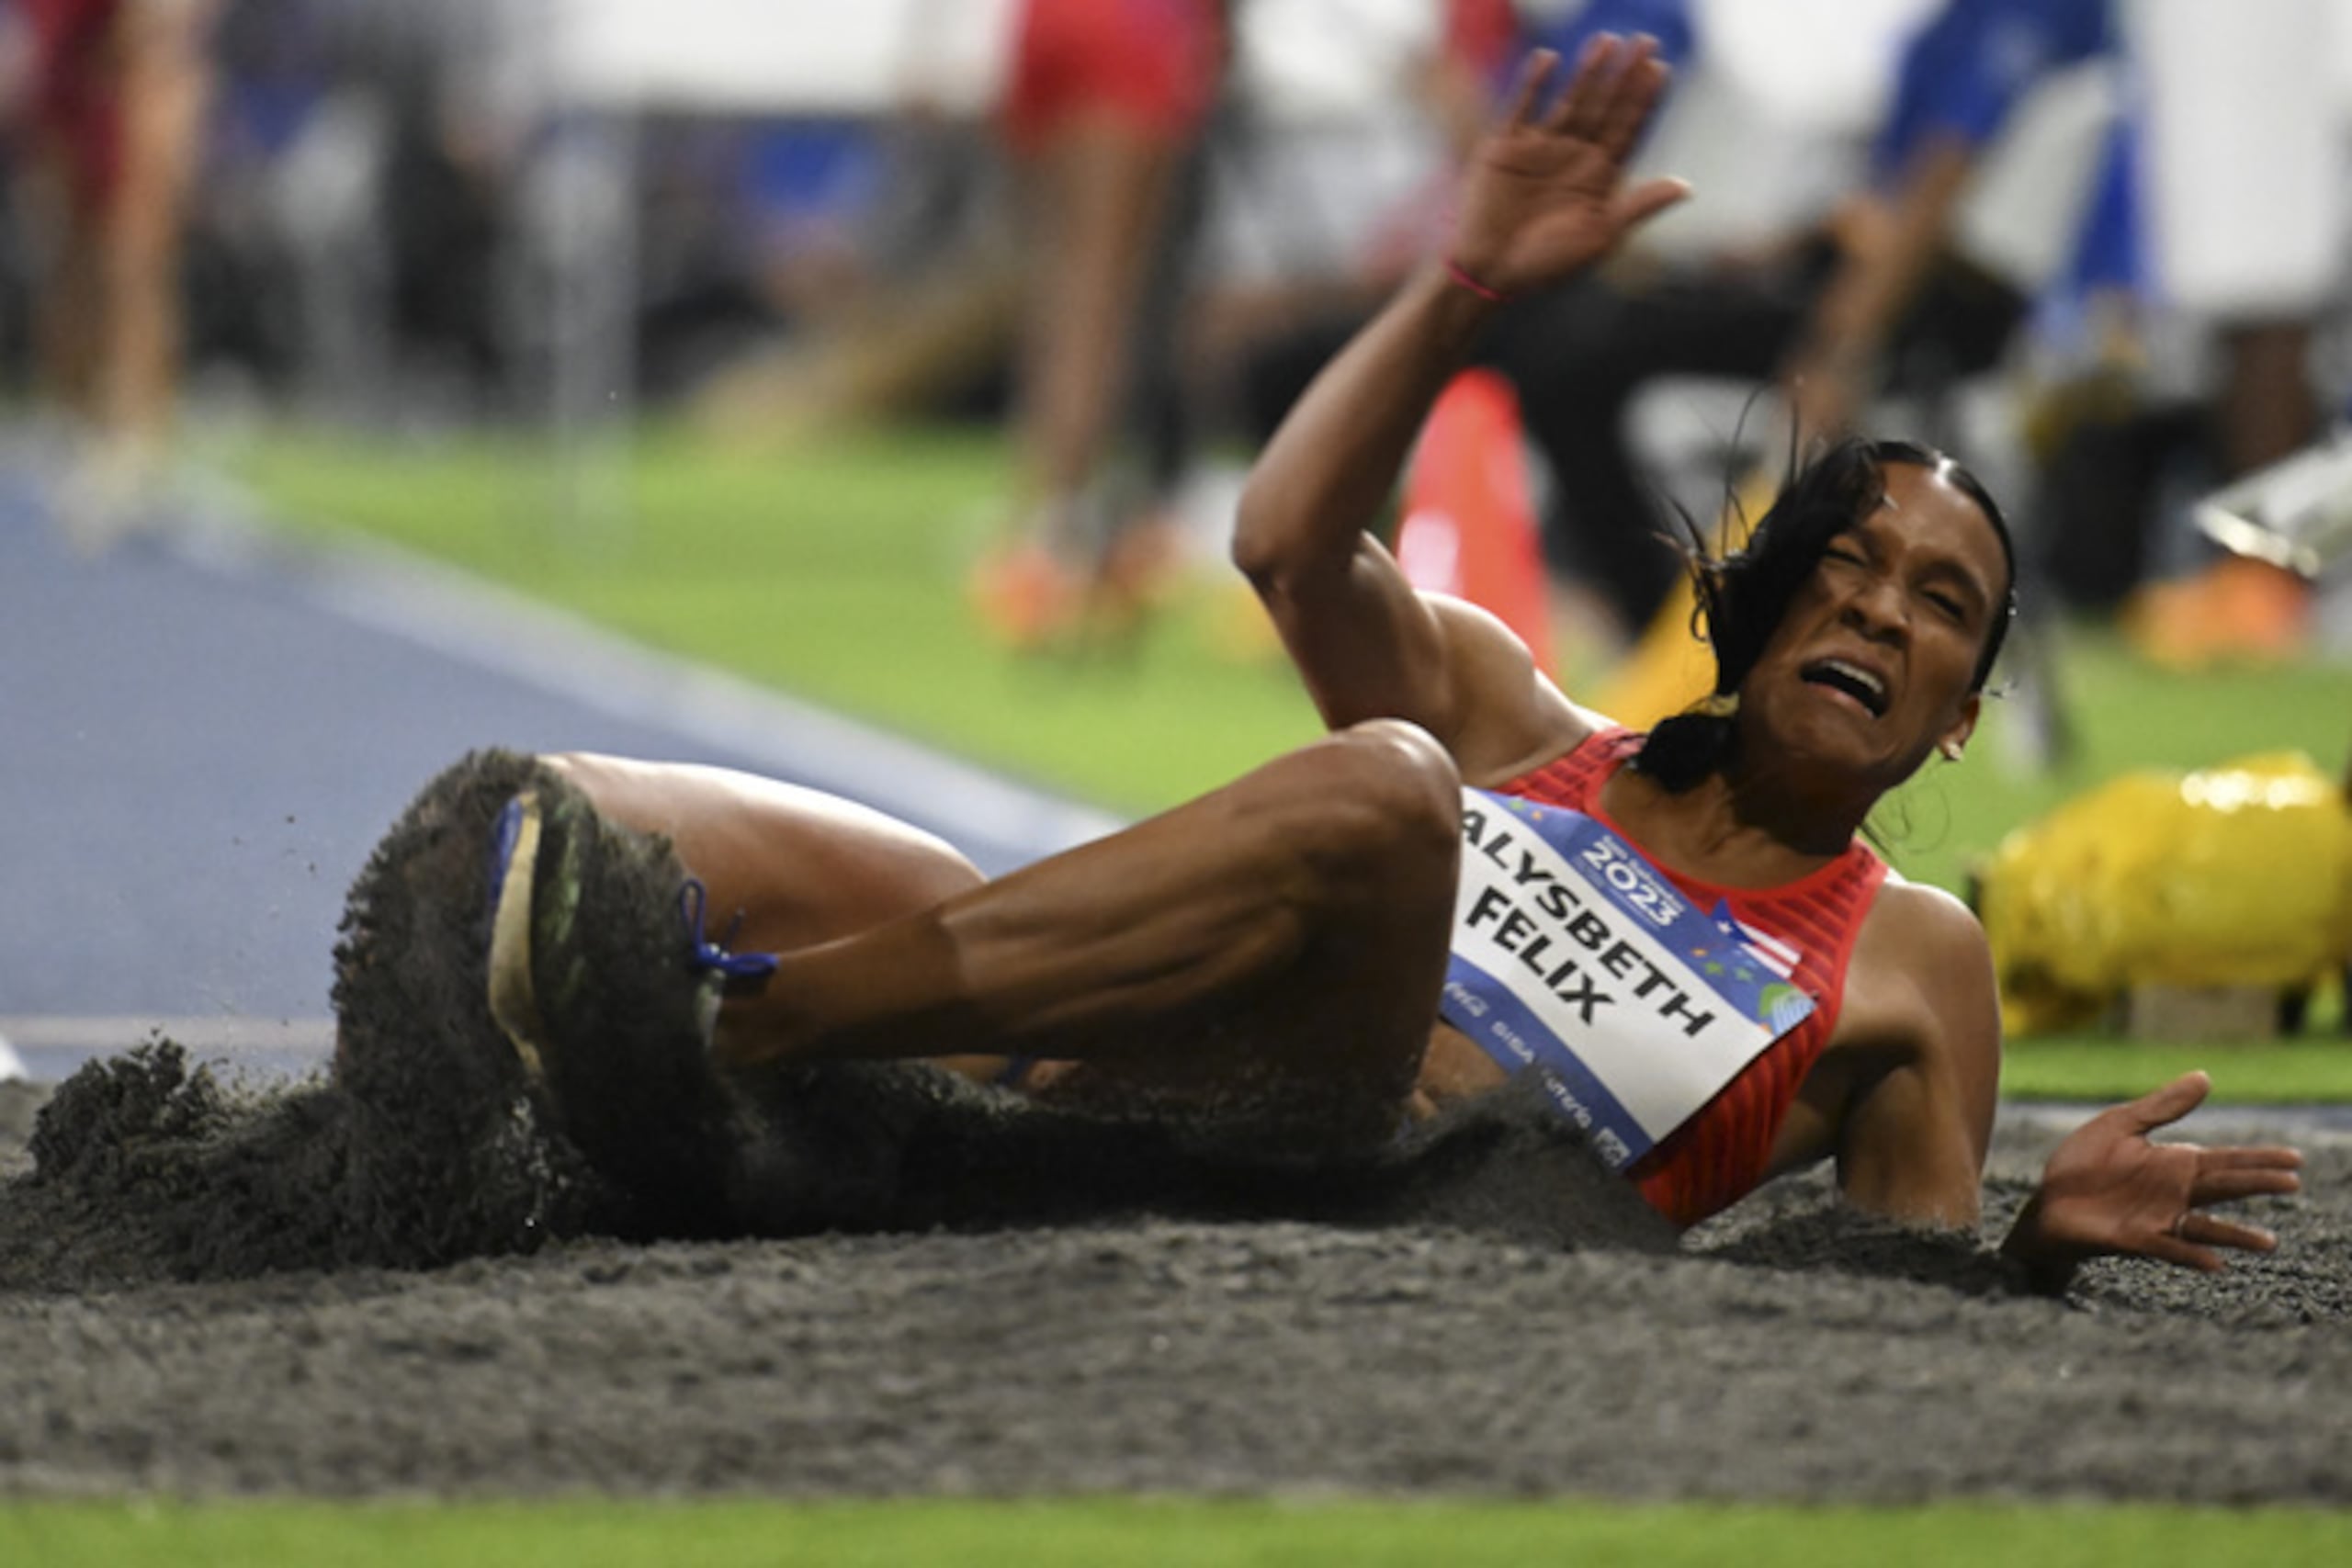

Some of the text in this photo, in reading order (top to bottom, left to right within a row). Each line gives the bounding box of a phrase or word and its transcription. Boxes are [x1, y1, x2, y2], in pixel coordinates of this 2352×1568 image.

[1463, 809, 1714, 1037] ALYSBETH
[1581, 840, 1680, 926] 2023
[1465, 886, 1615, 1026] FELIX
